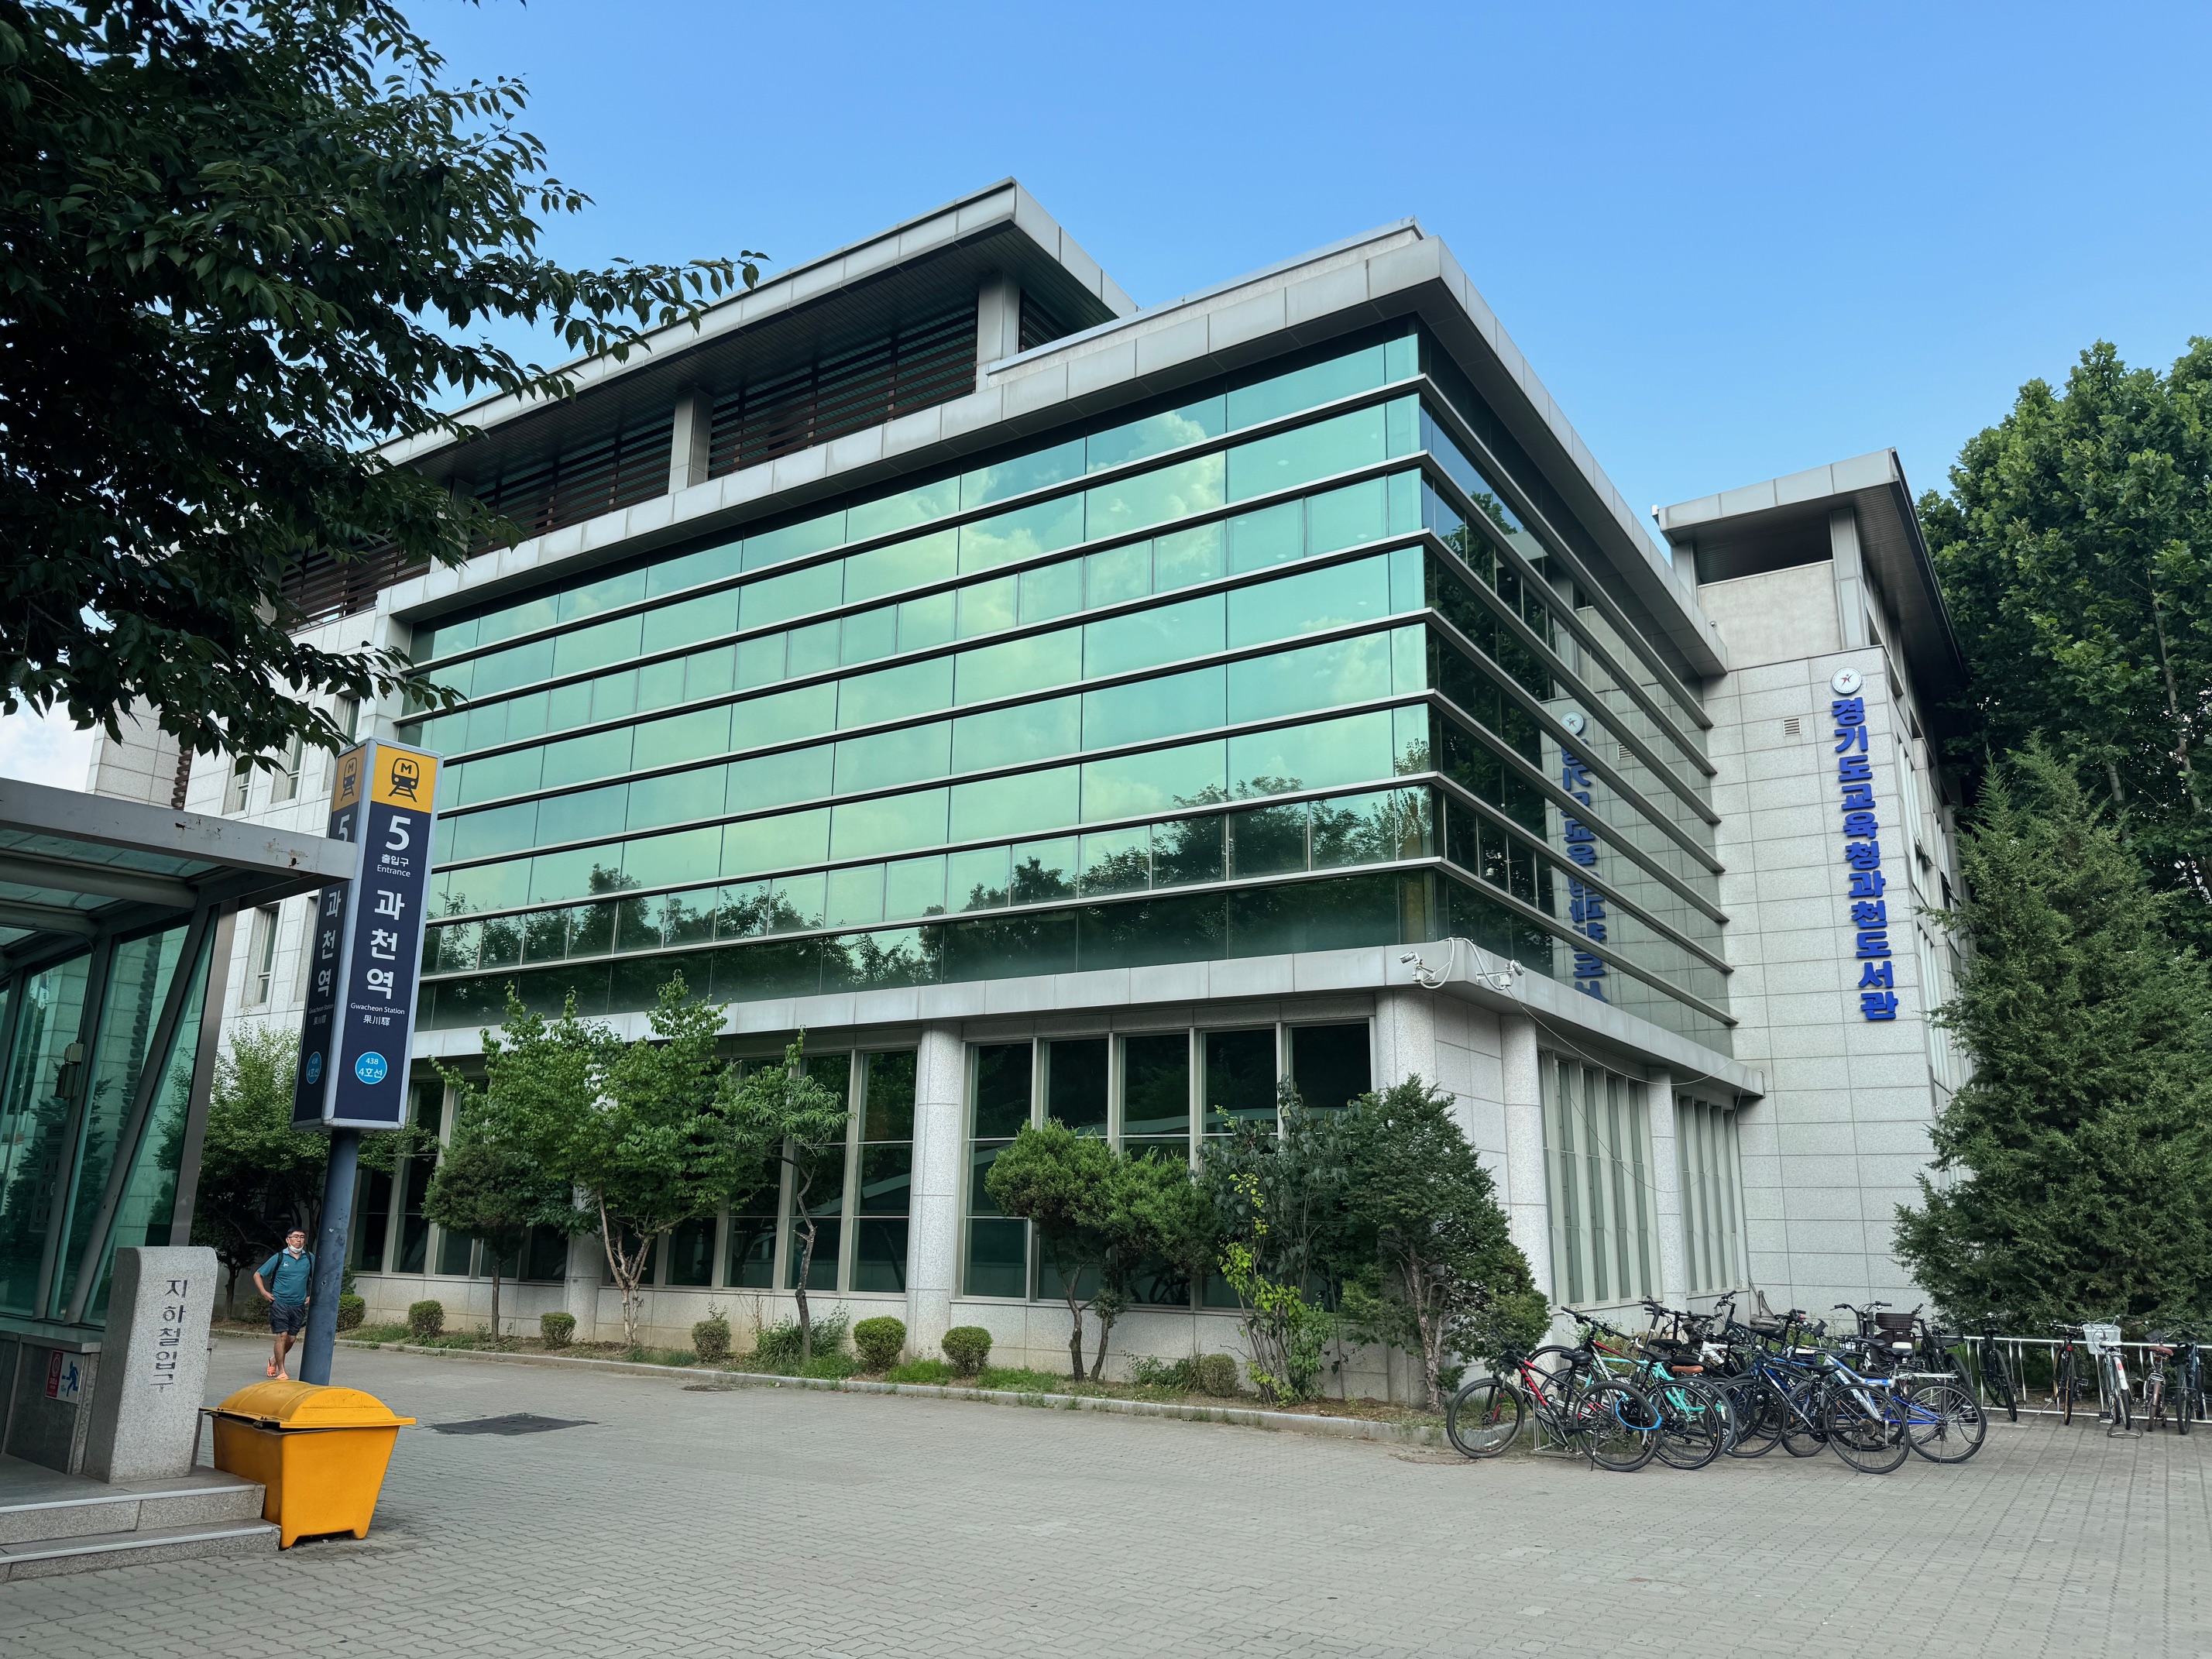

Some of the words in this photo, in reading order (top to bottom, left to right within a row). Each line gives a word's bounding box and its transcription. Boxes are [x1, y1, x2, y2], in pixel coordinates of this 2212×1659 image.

[338, 814, 350, 843] 5
[386, 815, 411, 851] 5
[377, 864, 410, 877] Entrance
[381, 854, 409, 867] 출입구
[1831, 696, 1898, 1021] 경기도교육청과천도서관
[318, 890, 341, 997] 과천역
[366, 890, 405, 999] 과천역
[350, 1002, 383, 1012] Gwacheon
[384, 1006, 405, 1015] Station
[359, 1068, 383, 1078] 4호선
[150, 1279, 188, 1393] 지하철입구
